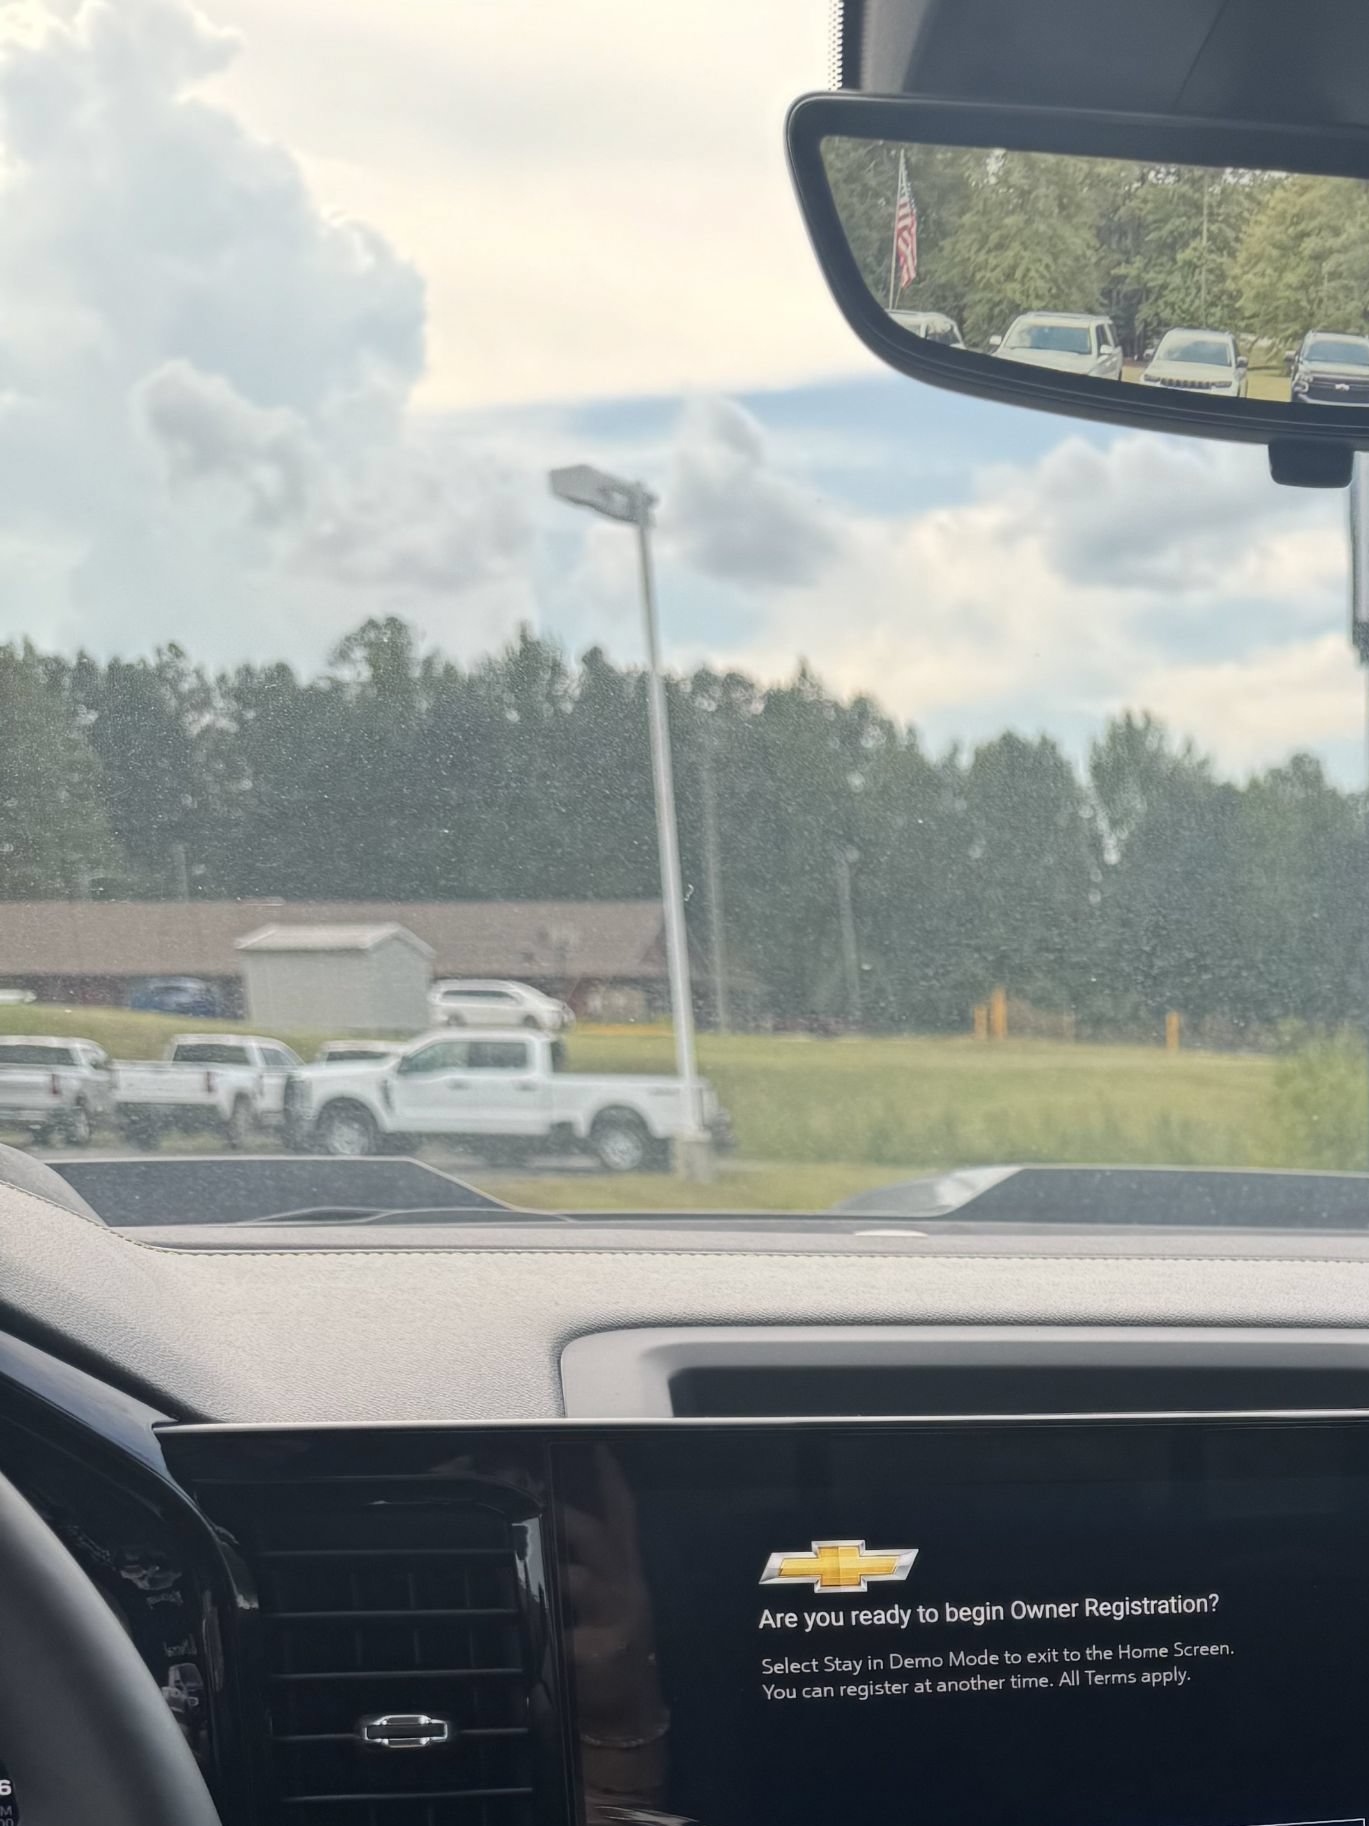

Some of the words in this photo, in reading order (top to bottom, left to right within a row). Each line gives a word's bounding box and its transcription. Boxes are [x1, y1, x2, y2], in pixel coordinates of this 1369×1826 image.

[758, 1608, 798, 1629] Are
[803, 1609, 844, 1632] you
[851, 1603, 911, 1629] ready
[916, 1604, 939, 1623] to
[945, 1601, 1005, 1626] begin
[1010, 1599, 1080, 1620] Owner
[1084, 1593, 1220, 1621] Registration?
[761, 1656, 818, 1675] Select
[823, 1655, 862, 1676] Stay
[867, 1655, 884, 1671] in
[889, 1652, 943, 1670] Demo
[949, 1648, 1000, 1667] Mode
[1003, 1649, 1022, 1665] to
[1026, 1647, 1059, 1664] exit
[1062, 1648, 1081, 1662] to
[1085, 1644, 1113, 1661] the
[1118, 1643, 1169, 1660] Home
[1173, 1641, 1235, 1658] Screen.
[762, 1683, 797, 1701] You
[802, 1684, 834, 1699] can
[839, 1679, 909, 1701] register
[913, 1677, 933, 1694] at
[936, 1674, 1005, 1692] another
[1010, 1673, 1054, 1689] time.
[1058, 1669, 1080, 1687] All
[1084, 1669, 1137, 1686] Terms
[1140, 1665, 1191, 1687] apply.
